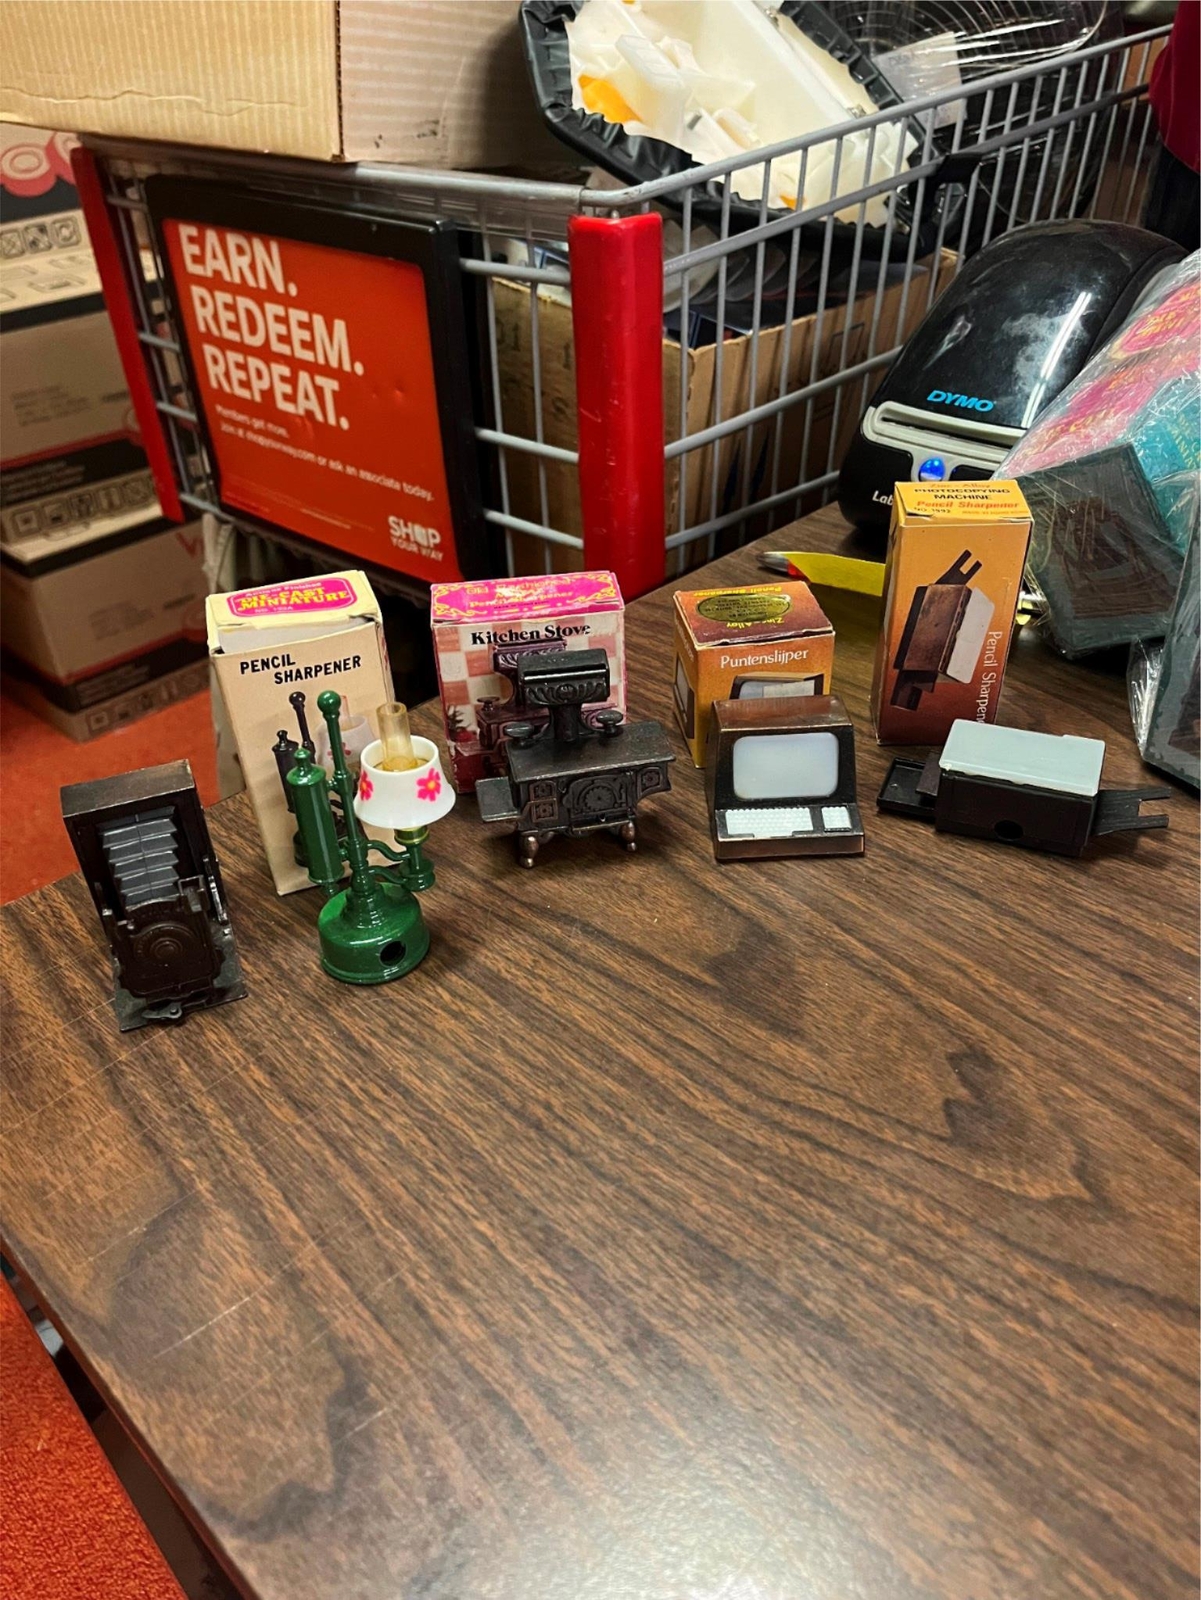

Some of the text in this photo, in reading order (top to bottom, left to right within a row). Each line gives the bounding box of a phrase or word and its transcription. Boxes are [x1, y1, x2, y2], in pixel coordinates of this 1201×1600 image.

[178, 223, 298, 297] EARN.
[190, 284, 365, 376] REDEEM.
[202, 343, 350, 430] REPEAT.
[926, 389, 994, 412] DYMO
[916, 500, 1020, 510] Pencil Sharpener
[387, 515, 441, 548] SHOP
[237, 590, 350, 612] MINIATURE
[471, 624, 592, 645] Kitchen Stove
[240, 653, 296, 675] PENCIL
[274, 655, 362, 685] SHARPENER
[720, 649, 809, 669] Puntenslijper
[976, 631, 1003, 724] Pencil Sharpen
